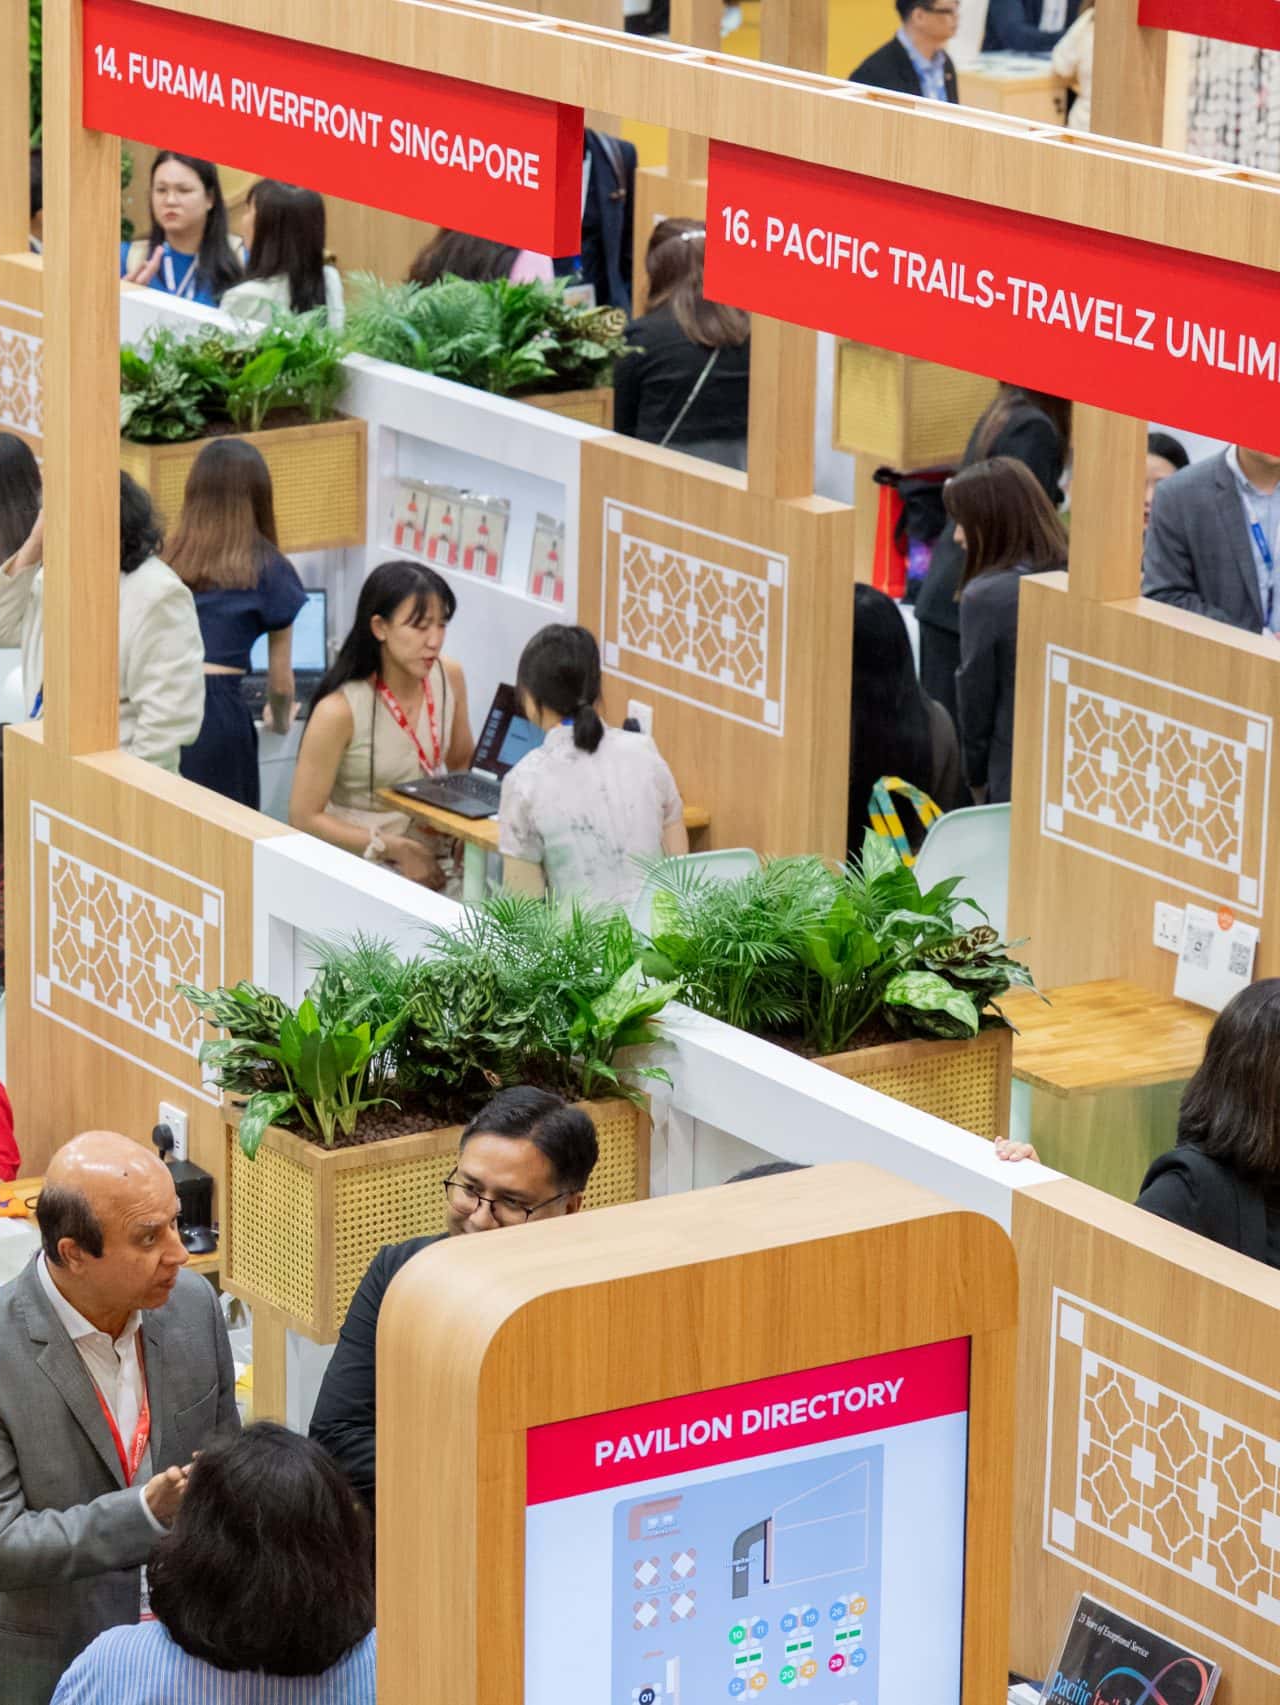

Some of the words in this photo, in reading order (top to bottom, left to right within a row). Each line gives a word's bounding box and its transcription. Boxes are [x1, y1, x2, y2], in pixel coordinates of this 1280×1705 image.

[95, 45, 122, 80] 14.
[129, 52, 224, 107] FURAMA
[232, 78, 382, 147] RIVERFRONT
[390, 119, 539, 189] SINGAPORE
[722, 207, 756, 248] 16.
[766, 217, 880, 278] PACIFIC
[889, 247, 1155, 350] TRAILS-TRAVELZ
[1167, 317, 1280, 383] UNLIM
[596, 1415, 732, 1466] PAVILION
[743, 1378, 903, 1434] DIRECTORY
[831, 1607, 842, 1617] 26
[805, 1614, 816, 1623] 19
[732, 1630, 743, 1641] 10
[1130, 1641, 1150, 1658] Service
[782, 1670, 794, 1681] 20
[641, 1692, 652, 1704] 01
